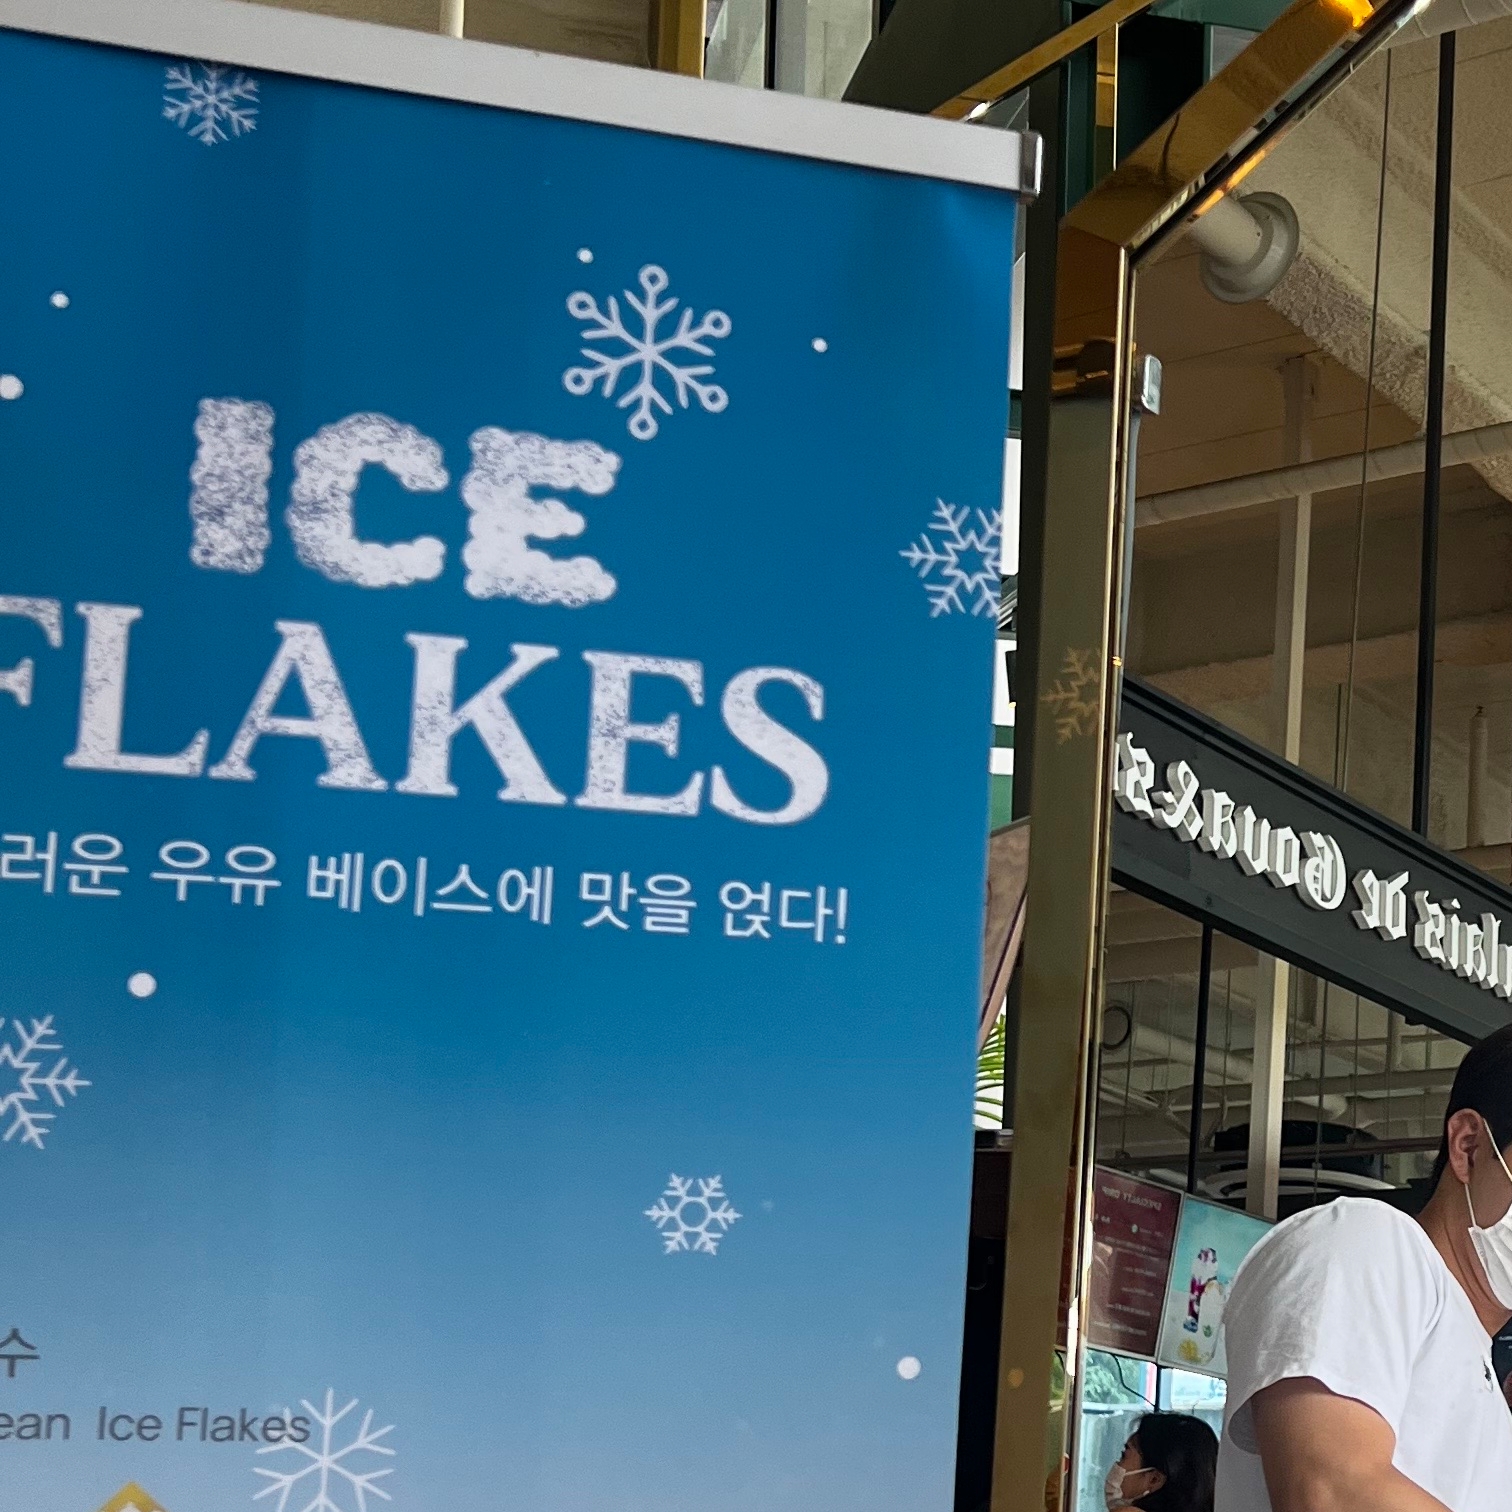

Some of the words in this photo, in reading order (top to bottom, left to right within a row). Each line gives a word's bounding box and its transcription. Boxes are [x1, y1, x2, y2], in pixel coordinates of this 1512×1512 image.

[190, 397, 622, 608] ICE
[1, 831, 130, 897] 러운
[150, 840, 282, 907] 우유
[306, 852, 555, 926] 베이스에
[578, 870, 698, 934] 맛을
[718, 880, 849, 945] 얹다!
[98, 1406, 162, 1442] Ice
[176, 1406, 312, 1443] Flakes
